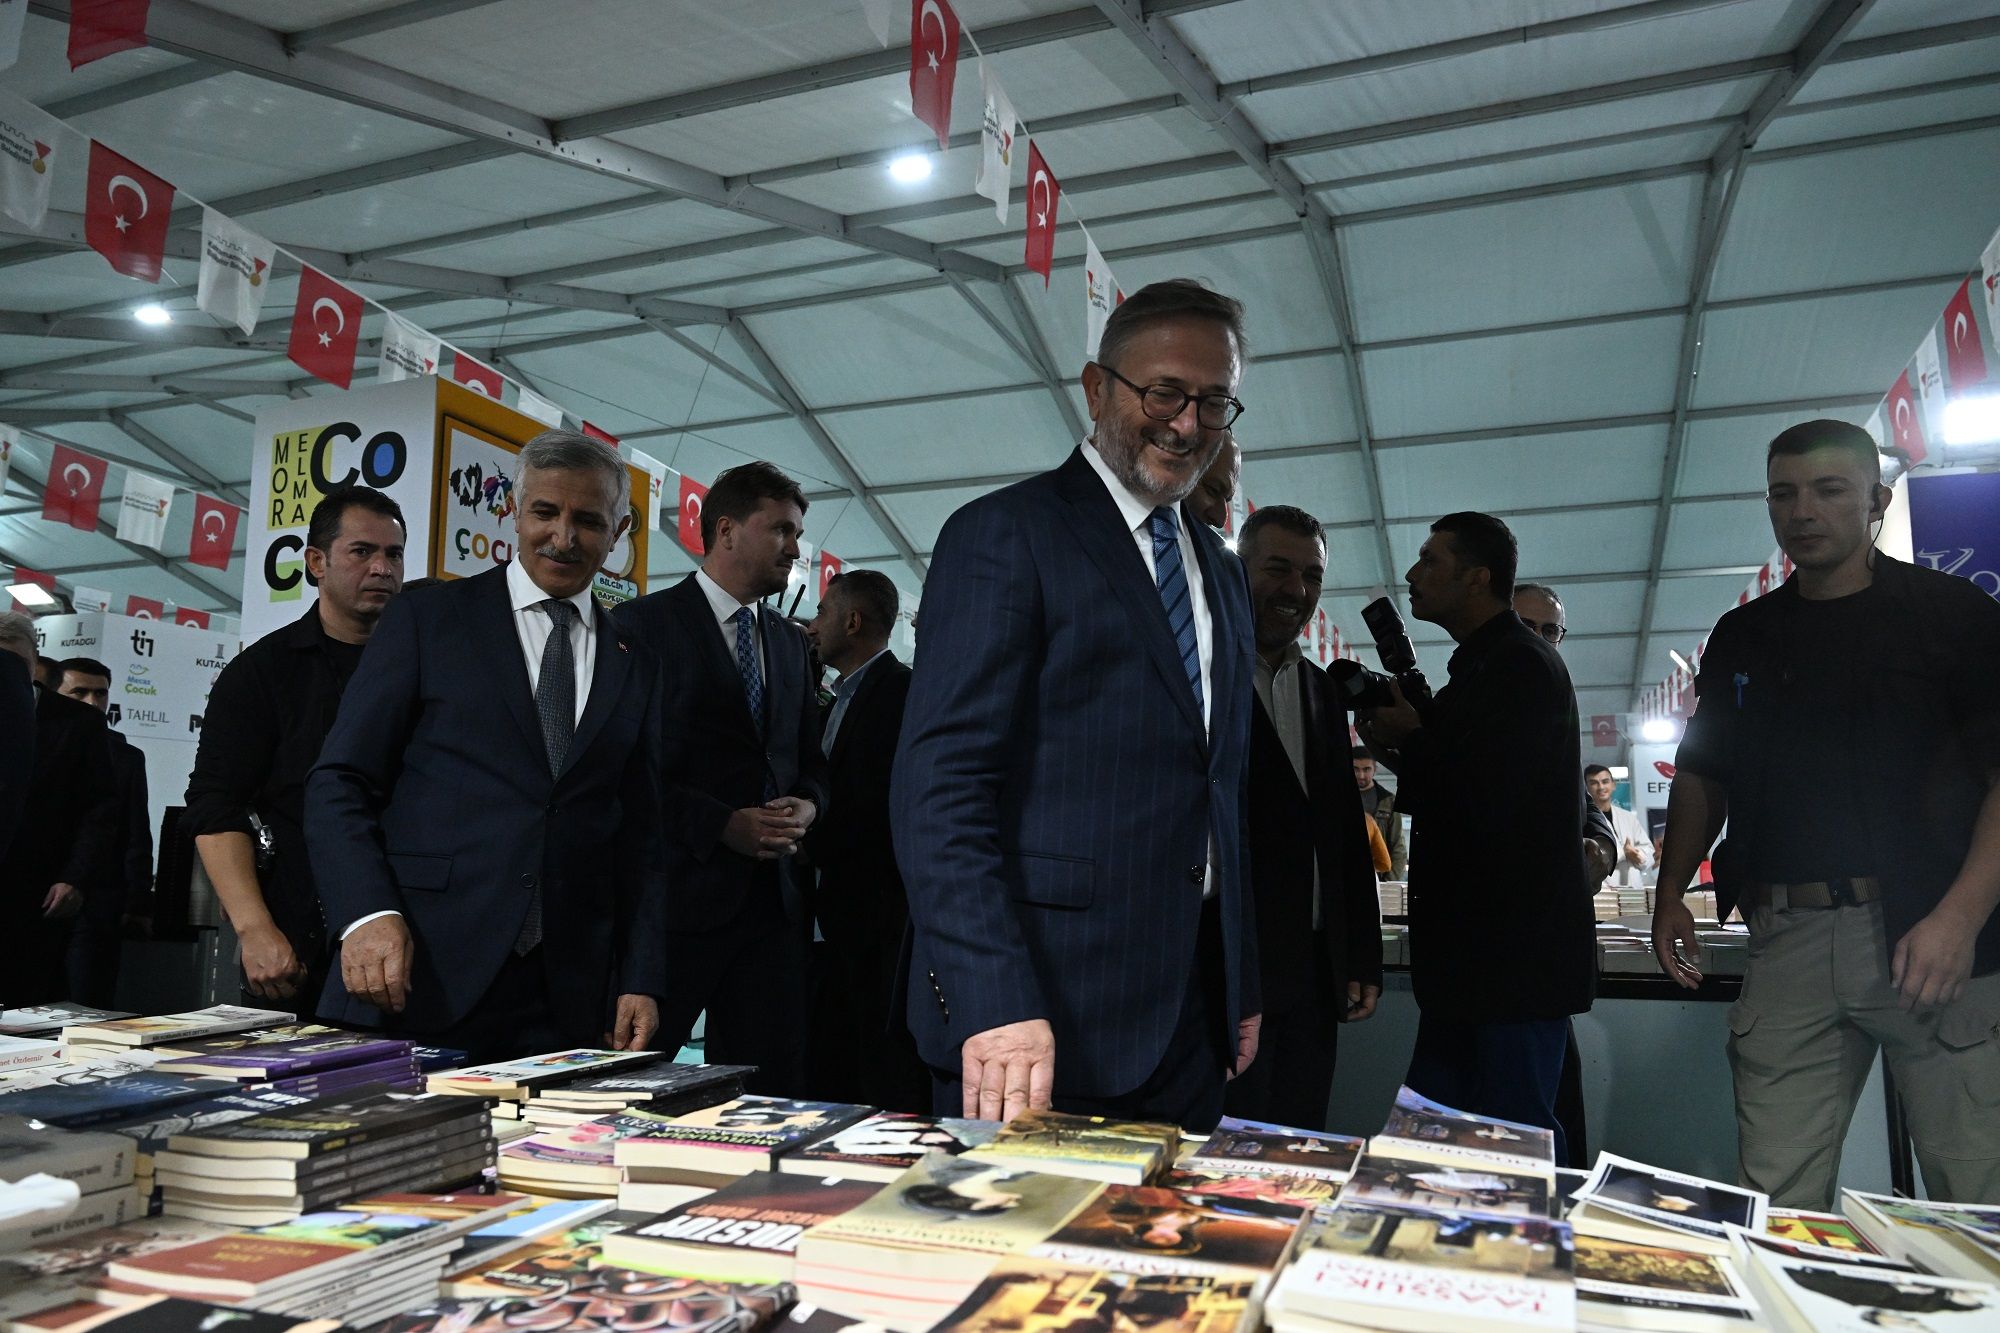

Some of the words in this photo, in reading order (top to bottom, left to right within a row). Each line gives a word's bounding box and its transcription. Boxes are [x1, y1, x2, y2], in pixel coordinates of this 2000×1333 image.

[272, 437, 290, 527] MOR
[291, 433, 309, 523] ELMA
[61, 638, 96, 648] KUTADGU
[124, 683, 157, 696] Çocuk
